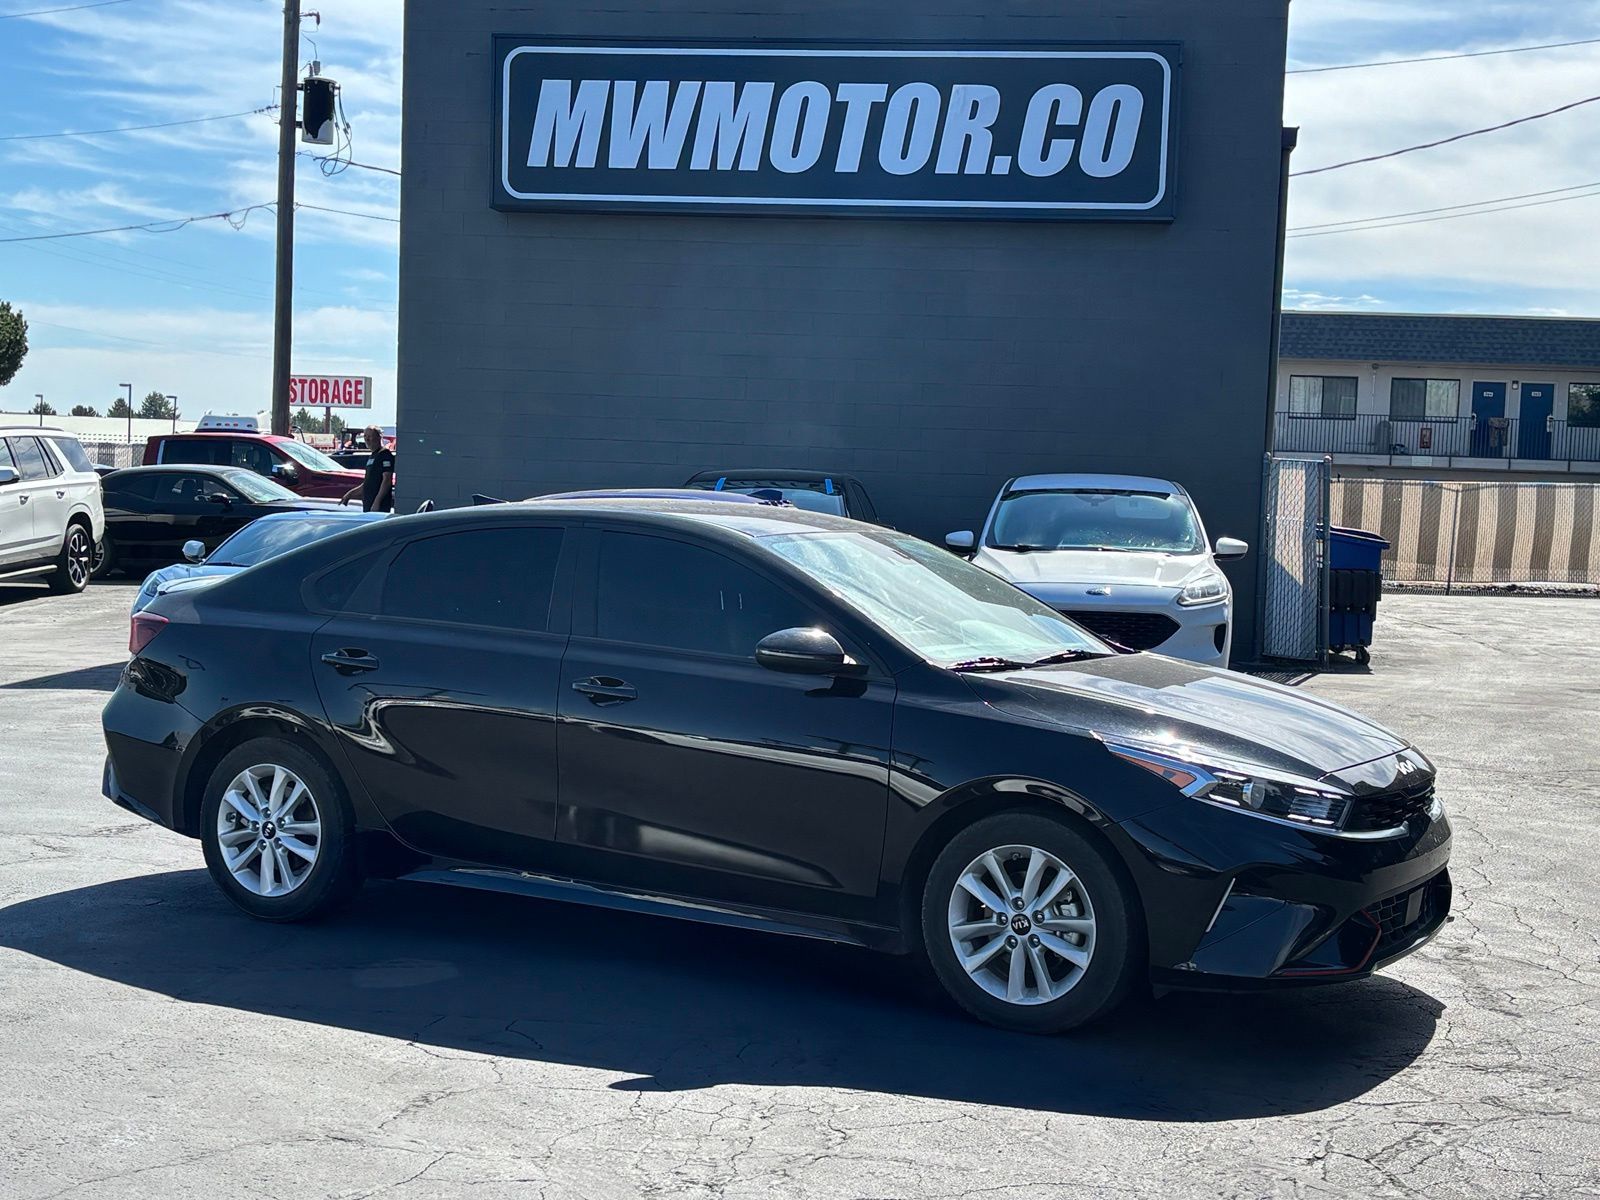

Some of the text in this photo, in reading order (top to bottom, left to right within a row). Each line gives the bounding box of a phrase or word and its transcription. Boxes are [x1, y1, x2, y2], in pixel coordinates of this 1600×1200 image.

[526, 79, 1144, 178] MWMOTOR.CO
[290, 377, 363, 405] STORAGE
[1012, 919, 1029, 930] KIA
